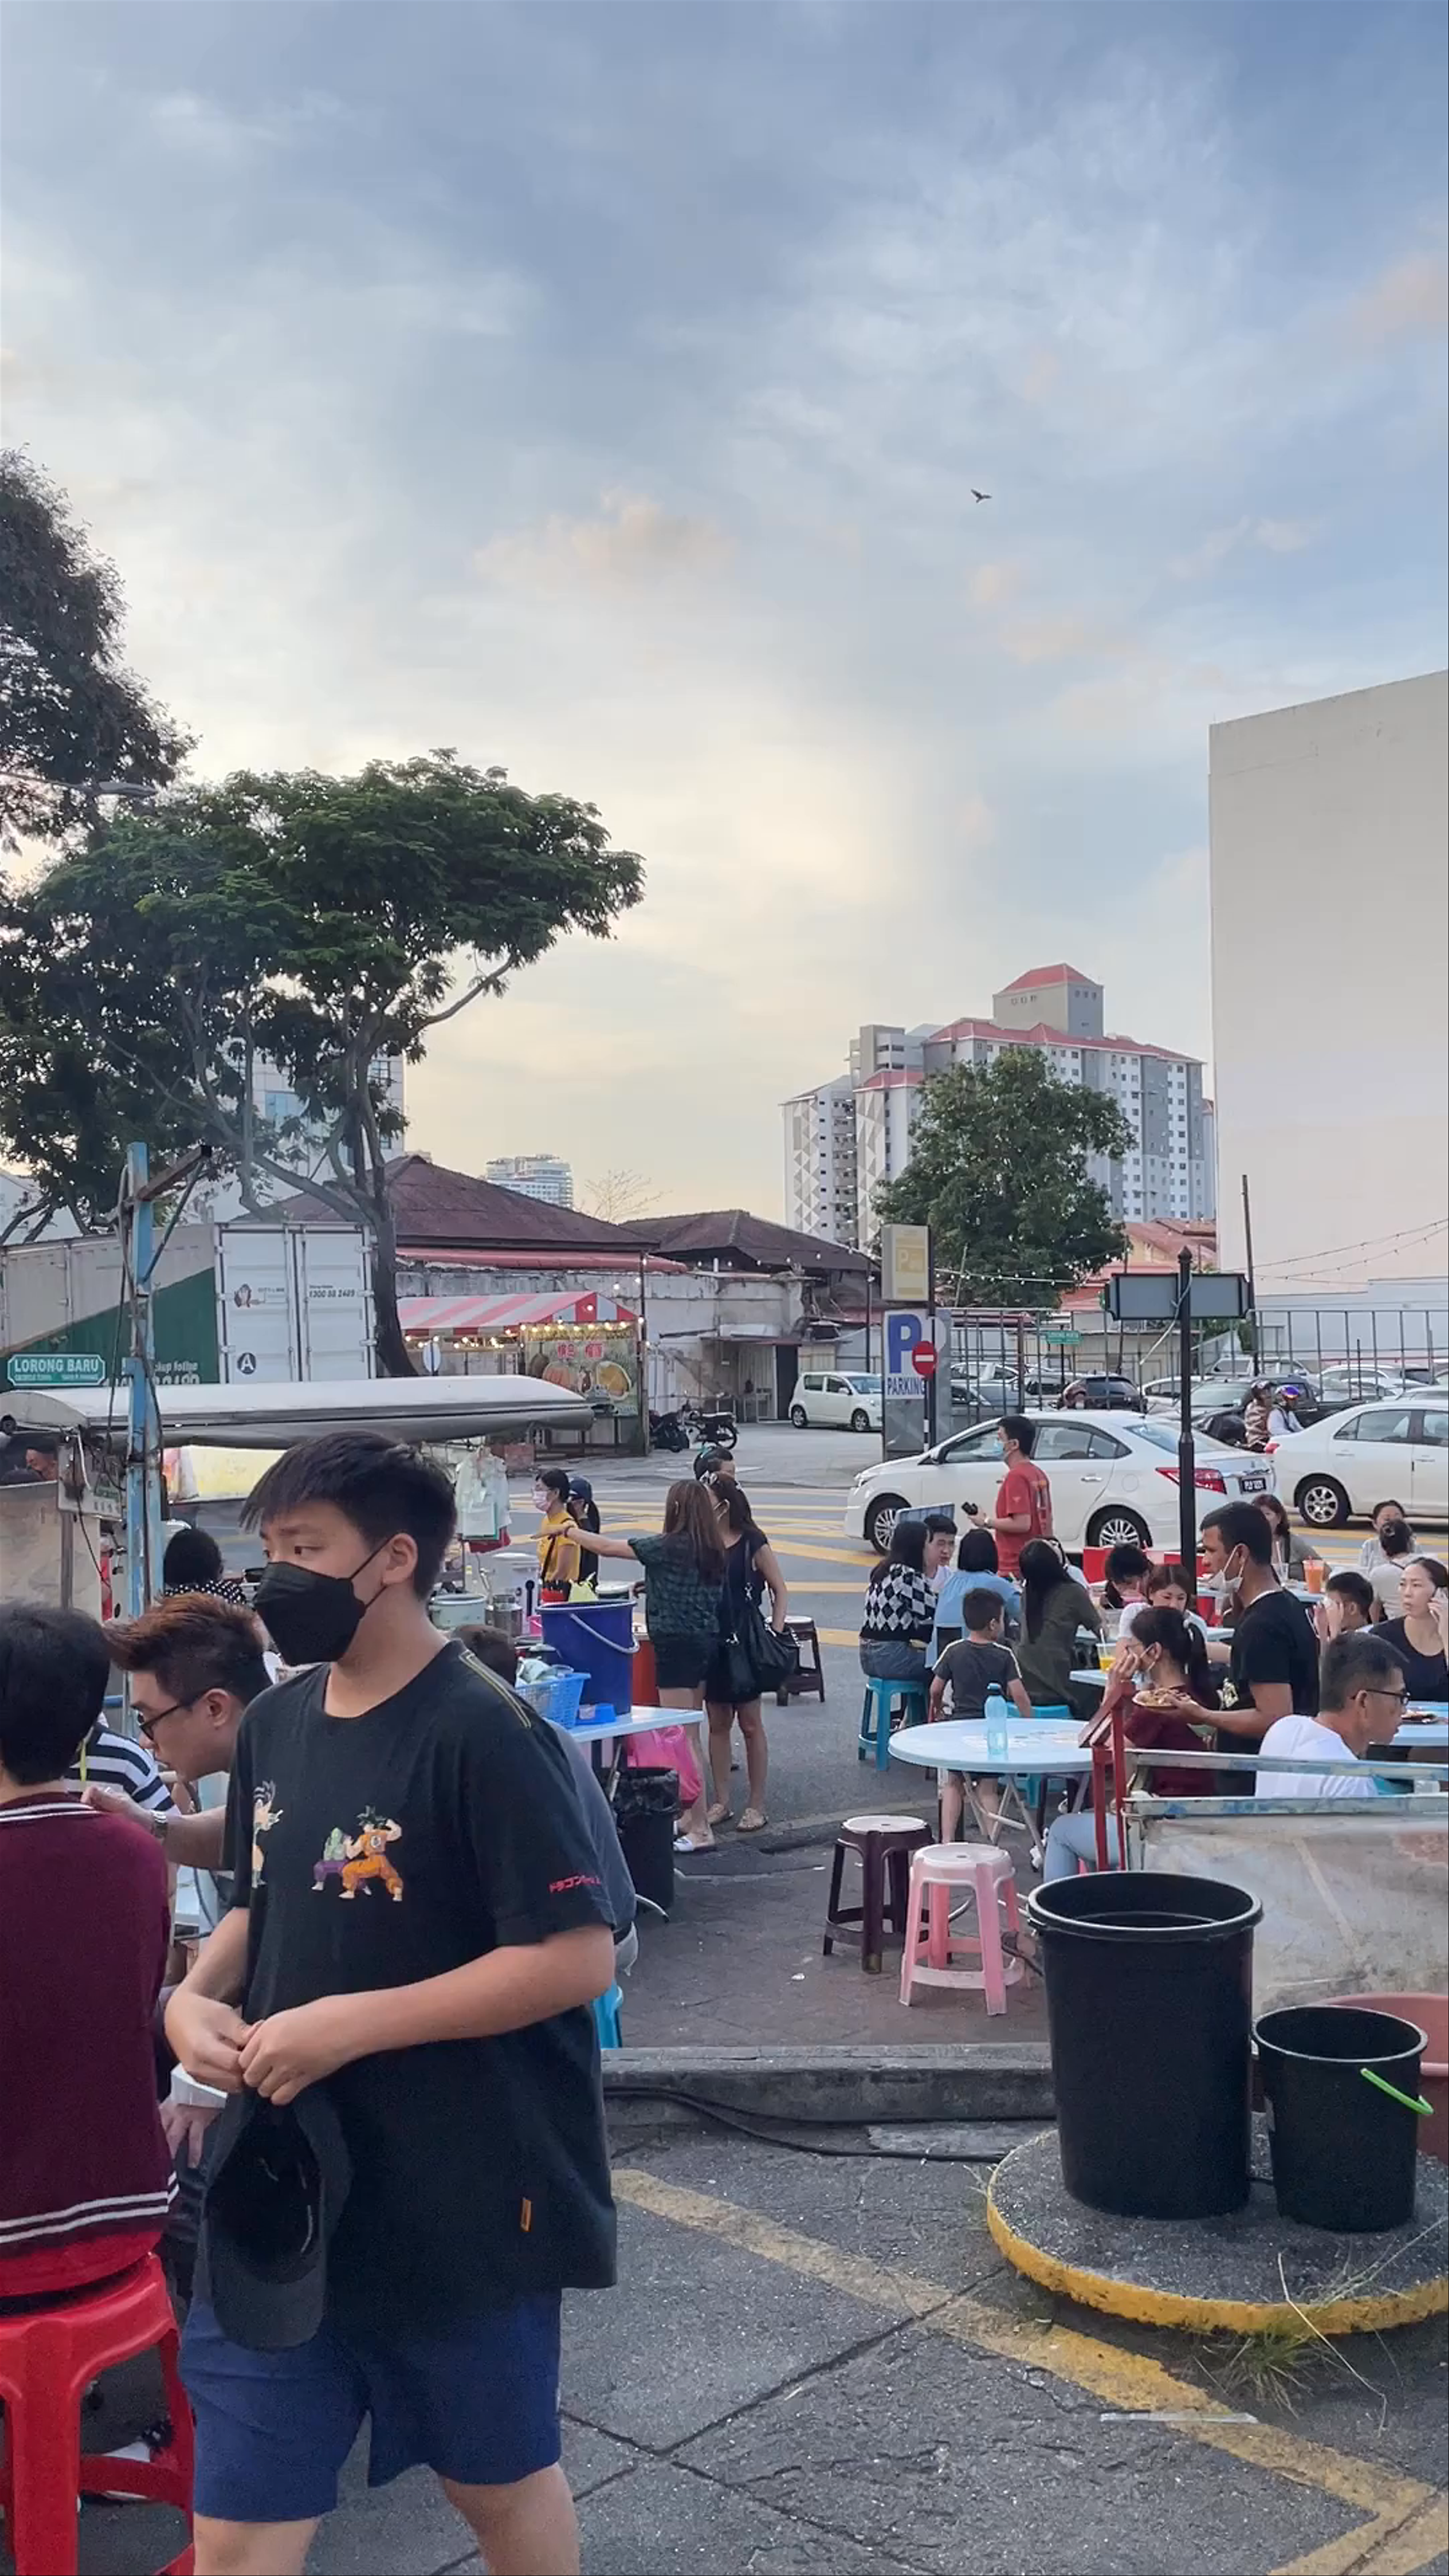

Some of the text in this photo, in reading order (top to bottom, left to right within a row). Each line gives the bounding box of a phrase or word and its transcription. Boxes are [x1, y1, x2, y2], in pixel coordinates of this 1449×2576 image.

[888, 1314, 922, 1373] P
[14, 1358, 99, 1373] LORONG BARU
[241, 1354, 254, 1370] A
